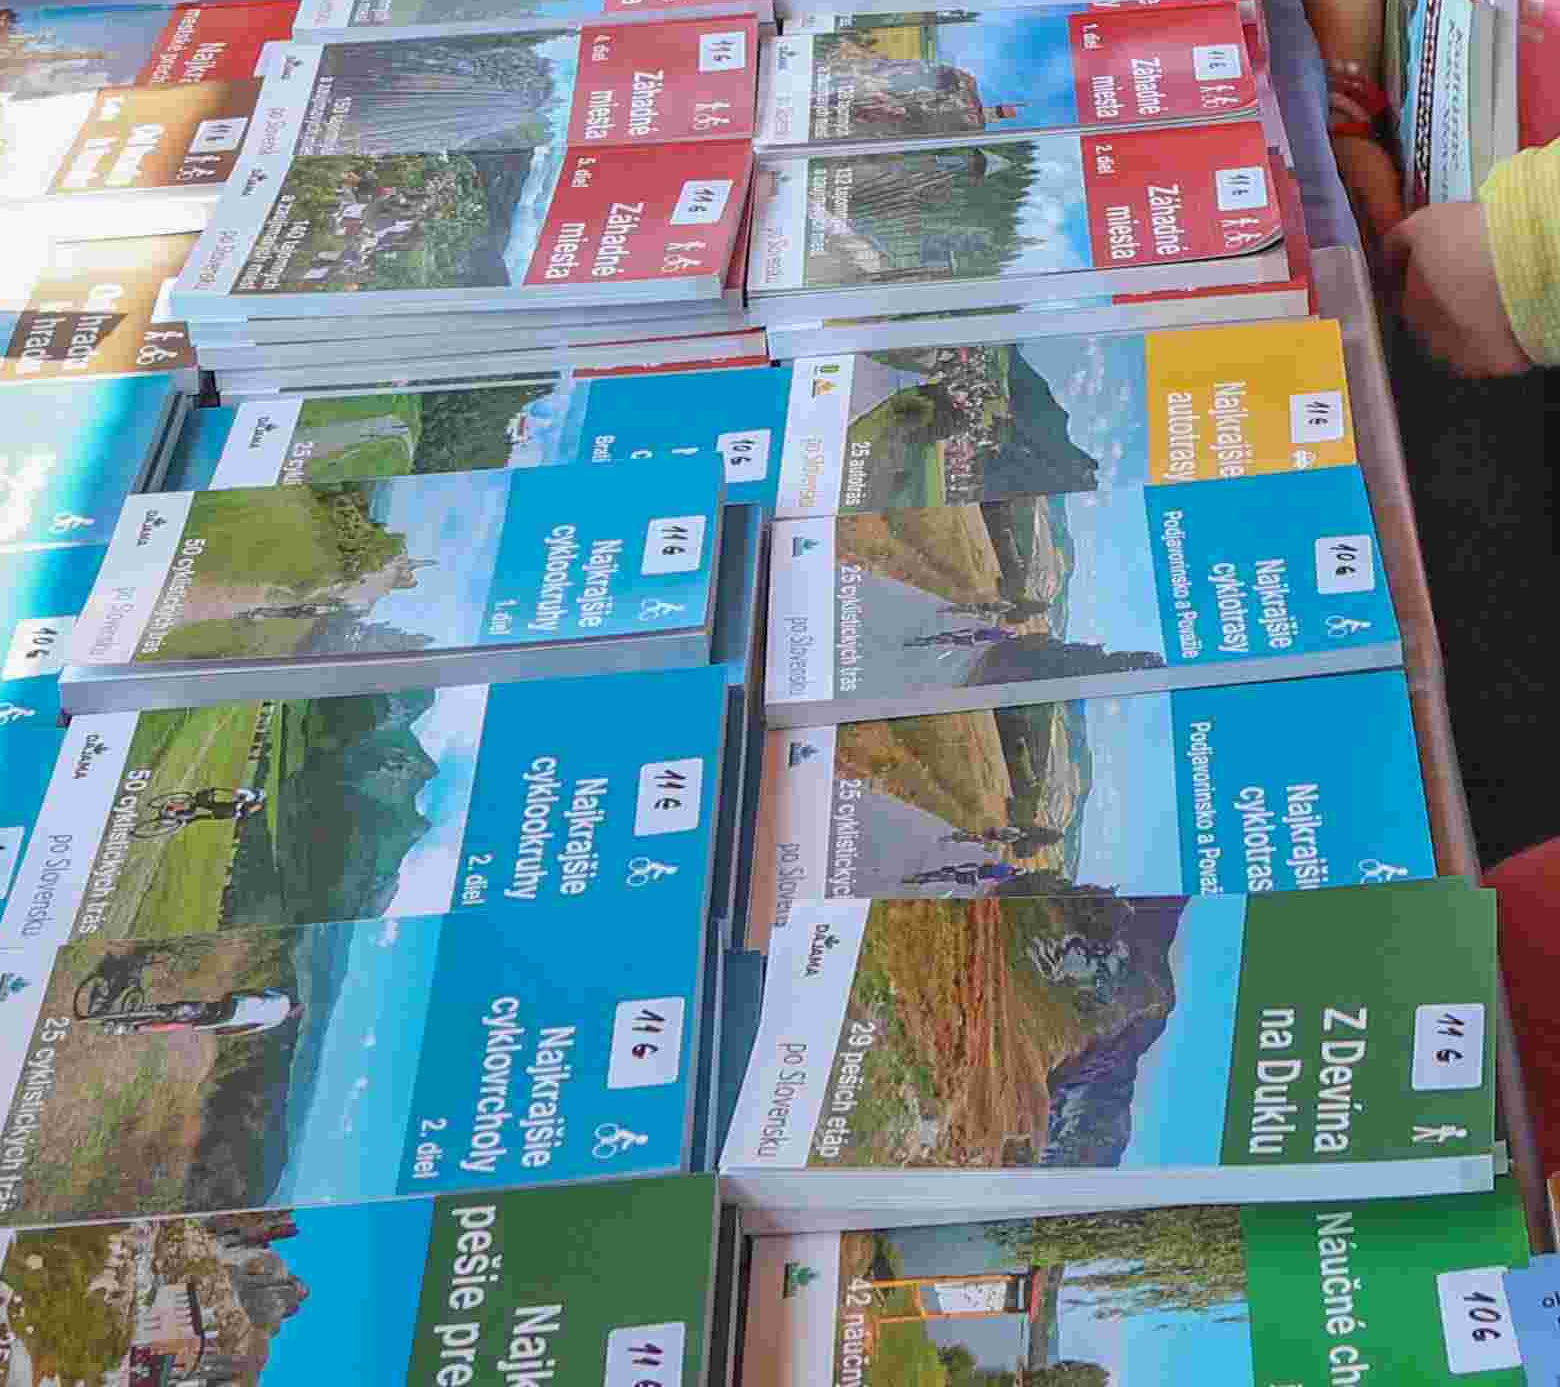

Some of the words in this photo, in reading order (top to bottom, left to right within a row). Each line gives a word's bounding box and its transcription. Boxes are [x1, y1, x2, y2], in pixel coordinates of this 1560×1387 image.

[628, 70, 663, 136] Záhadné
[1091, 76, 1122, 118] miesta
[1130, 57, 1169, 115] Záhadné
[585, 89, 615, 140] miesta
[576, 156, 596, 168] 5.
[1095, 144, 1114, 154] 2.
[1095, 154, 1117, 176] diel
[571, 169, 594, 188] diel
[591, 202, 643, 277] Záhadné
[1104, 205, 1139, 260] miesta
[1146, 184, 1190, 256] Záhadné
[544, 221, 586, 280] miesta
[850, 440, 871, 457] 25
[1162, 391, 1202, 482] autotrasy
[1211, 380, 1252, 478] Najkrajšie
[844, 458, 869, 507] autotrás
[180, 538, 207, 555] 50
[1159, 510, 1194, 598] Podjavorinsko
[151, 557, 201, 630] cyklistických
[528, 524, 578, 631] cyklookruhy
[578, 538, 624, 628] Najkrajšie
[840, 564, 862, 583] 25
[489, 613, 513, 635] diel
[494, 598, 517, 610] 1.
[837, 585, 864, 666] cyklistických
[1208, 562, 1254, 654] cyklotrasy
[1249, 559, 1296, 650] Najkrajšie
[140, 630, 168, 654] trás
[1176, 611, 1205, 659] Považie
[788, 635, 815, 698] Slovensku
[838, 668, 864, 692] trás
[72, 733, 100, 780] DAJAMA
[123, 768, 153, 792] 50
[1183, 720, 1218, 829] Podjavorinsko
[837, 778, 860, 801] 25
[46, 833, 76, 855] po
[91, 795, 143, 898] cyklistických
[503, 755, 560, 901] cyklookruhy
[558, 776, 610, 897] Najkrajšie
[773, 842, 802, 863] po
[1232, 786, 1276, 893] cyklotras
[1277, 783, 1324, 891] Najkrajši
[465, 852, 494, 872] 2.
[1194, 846, 1228, 897] Považ
[18, 857, 76, 938] Slovensku
[78, 900, 110, 934] trás
[459, 875, 491, 906] diel
[804, 923, 832, 979] DAJAMA
[40, 1017, 72, 1042] 25
[848, 1021, 878, 1049] 29
[1260, 1007, 1297, 1049] na
[1322, 1007, 1367, 1031] Z
[776, 1041, 808, 1067] po
[829, 1050, 871, 1110] peších
[4, 1047, 64, 1171] cyklistických
[458, 995, 526, 1174] cyklovrcholy
[520, 1025, 577, 1169] Najkrajšie
[1247, 1057, 1299, 1155] Duklu
[1311, 1040, 1364, 1154] Devína
[417, 1117, 448, 1140] 2.
[757, 1069, 806, 1159] Slovensku
[816, 1112, 857, 1160] etáp
[410, 1141, 444, 1180] diel
[452, 1204, 500, 1309] pešie
[1316, 1211, 1367, 1339] Náučné
[848, 1275, 874, 1306] 42
